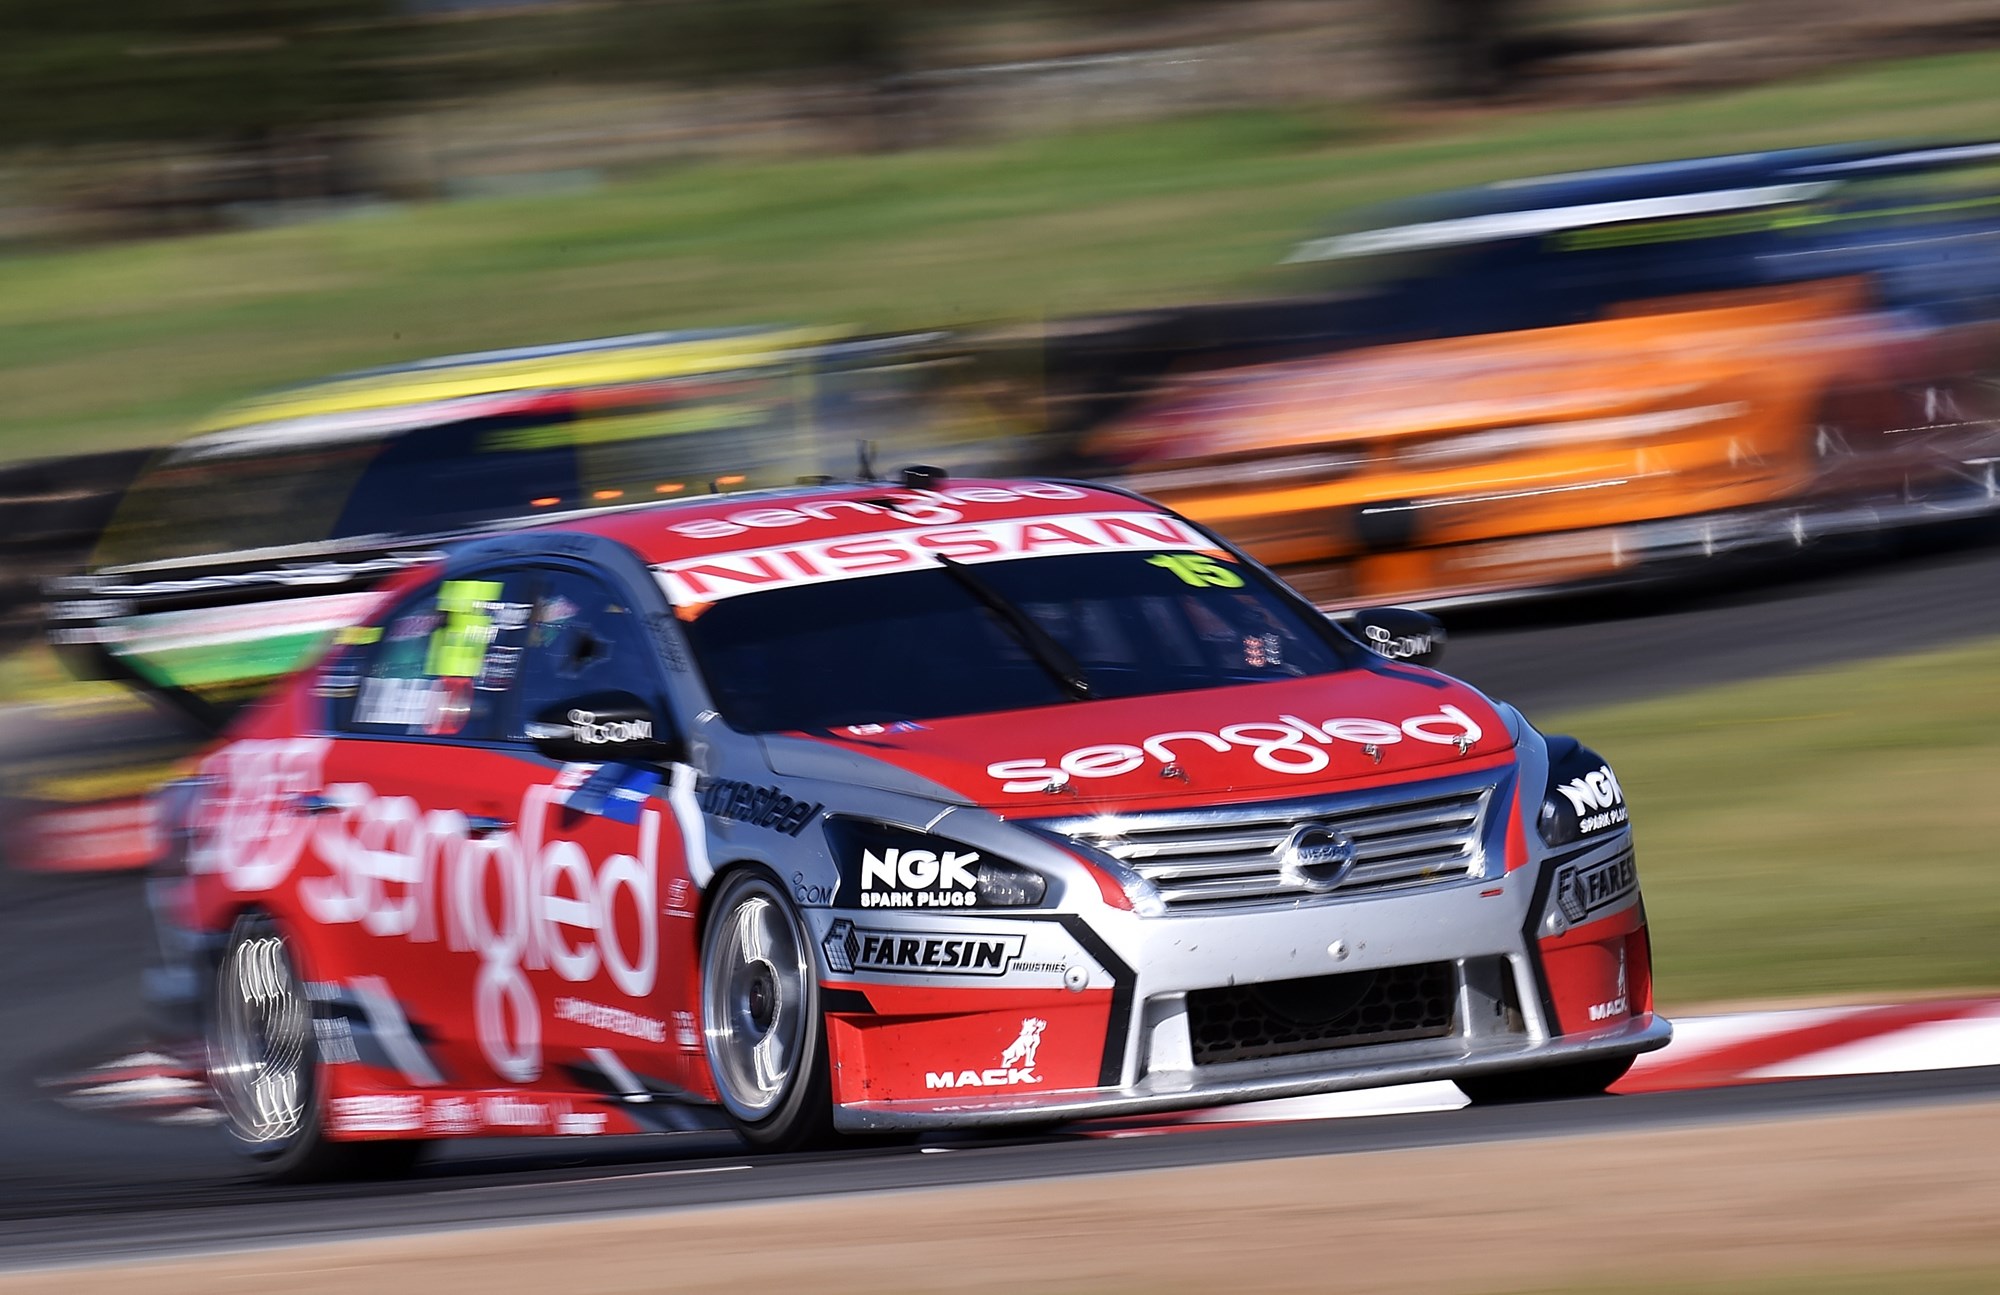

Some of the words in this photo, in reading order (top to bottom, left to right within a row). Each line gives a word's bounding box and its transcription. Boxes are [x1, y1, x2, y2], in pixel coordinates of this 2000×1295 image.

[667, 480, 1088, 539] sengled
[678, 515, 1192, 594] NISSAN
[1144, 552, 1245, 589] 15
[986, 704, 1484, 794] sengled
[861, 848, 980, 890] NGK
[860, 892, 914, 907] SPARK
[917, 891, 977, 907] PLUGS
[296, 780, 661, 1084] sengled
[861, 937, 1005, 968] FARESIN
[1011, 961, 1066, 973] INDUSTRIES
[925, 1067, 1038, 1089] MACK
